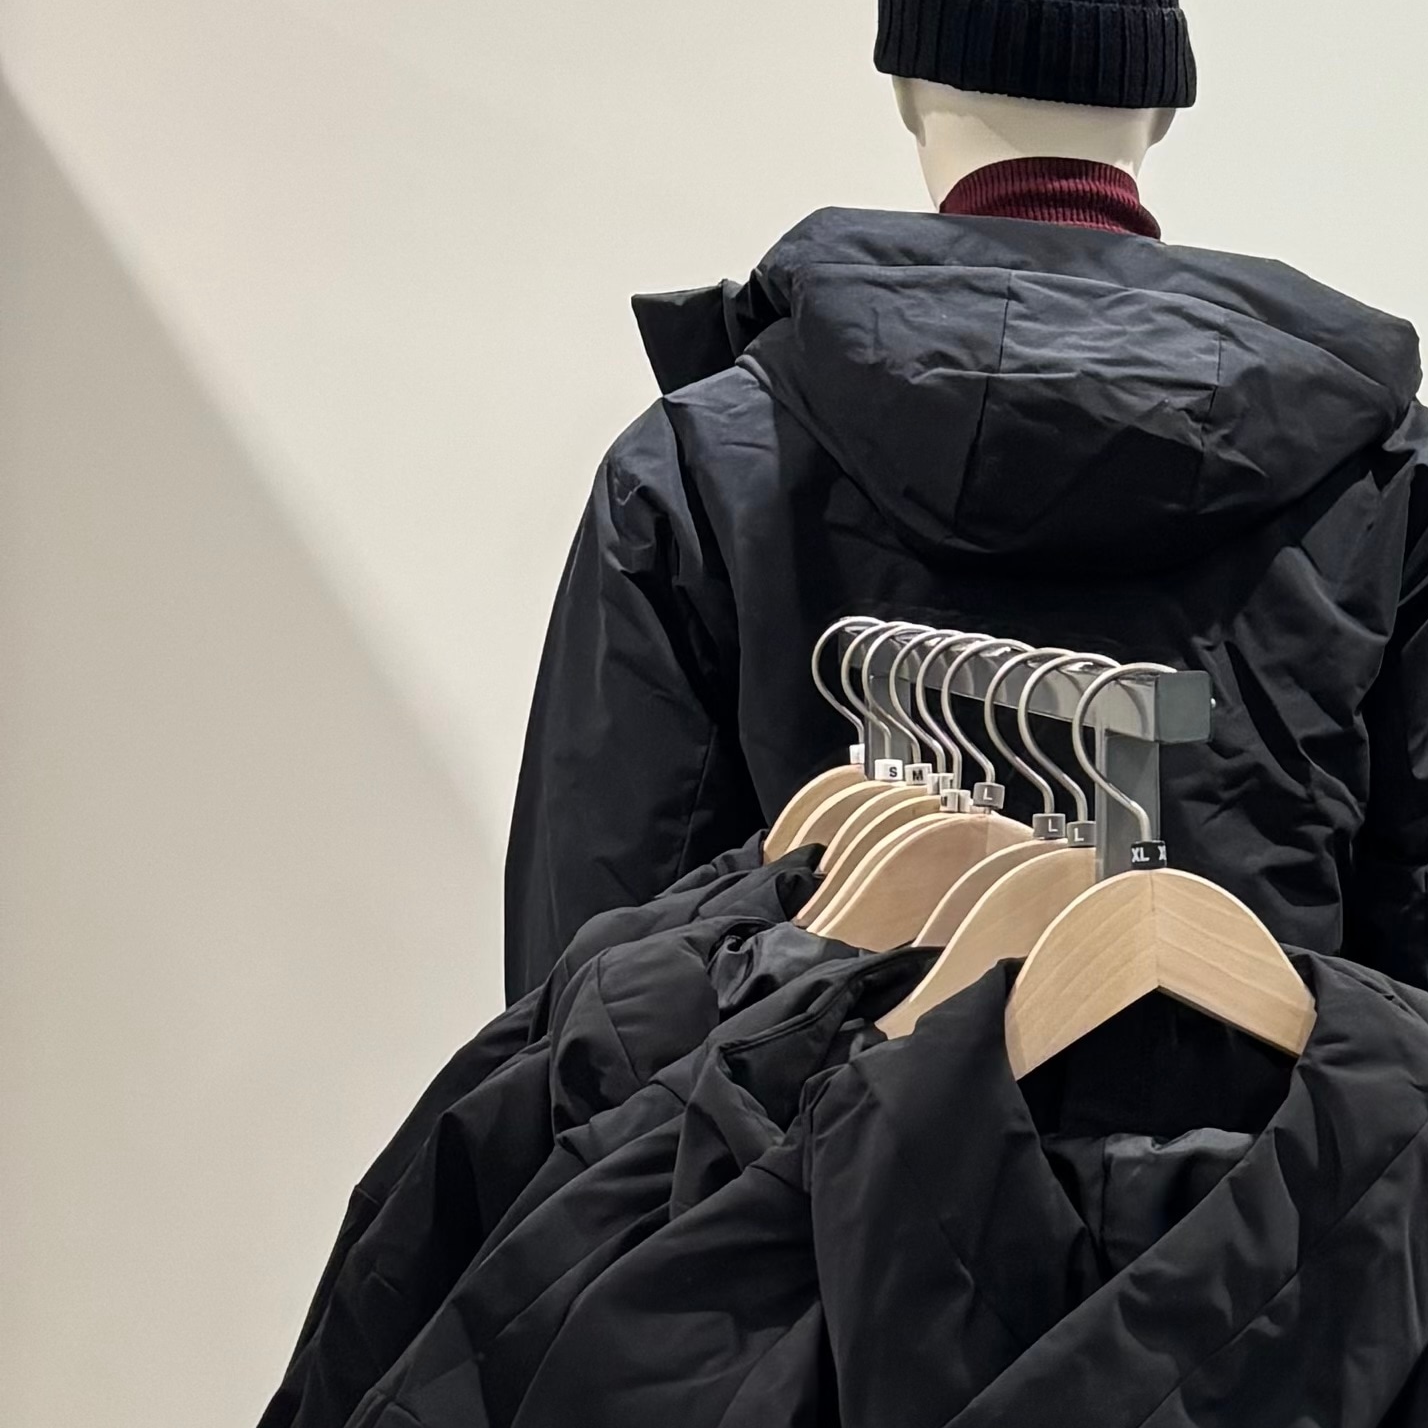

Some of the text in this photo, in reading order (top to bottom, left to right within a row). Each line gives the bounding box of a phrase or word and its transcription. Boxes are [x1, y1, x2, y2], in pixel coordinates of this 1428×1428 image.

[889, 766, 898, 778] S
[912, 769, 924, 781] M
[983, 786, 993, 801] L
[1048, 818, 1059, 832] L
[1074, 827, 1085, 842] L
[1131, 845, 1167, 863] XL X
